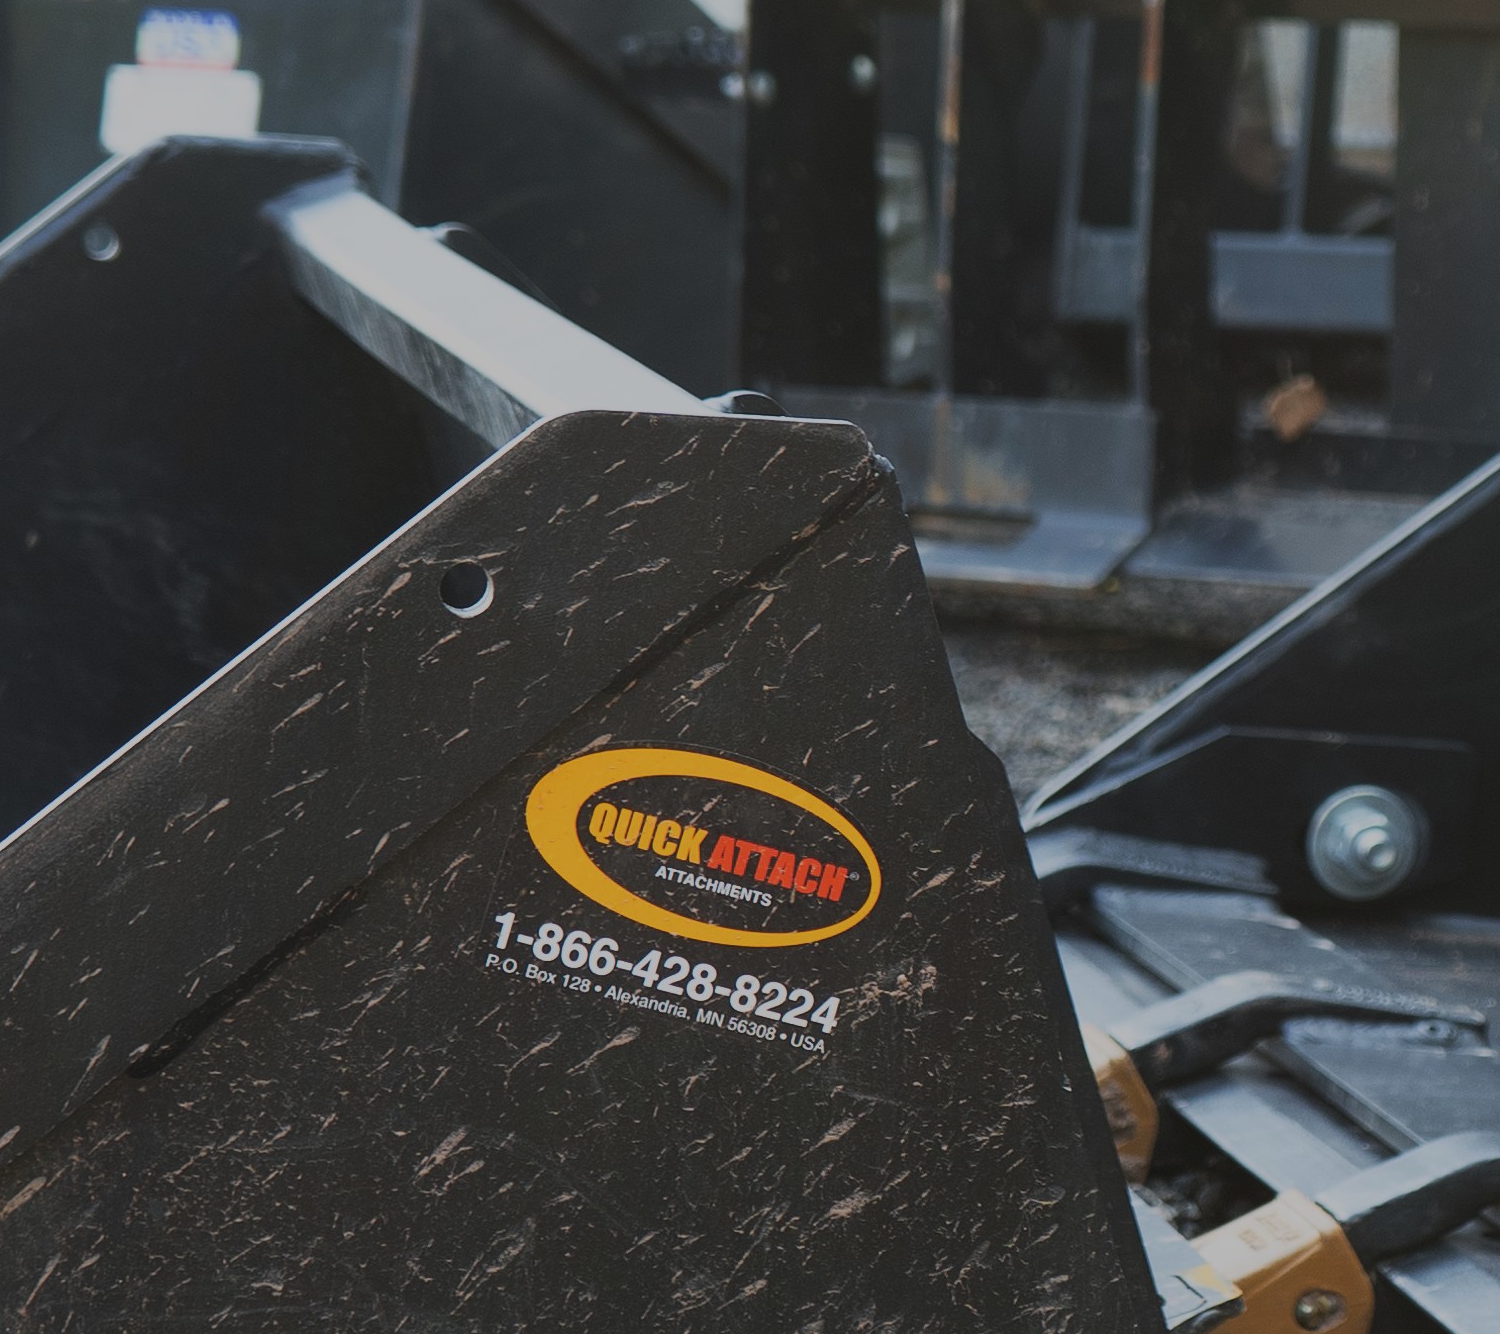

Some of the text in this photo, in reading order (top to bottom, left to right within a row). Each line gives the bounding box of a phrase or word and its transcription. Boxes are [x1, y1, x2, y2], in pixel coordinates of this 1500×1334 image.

[588, 802, 849, 902] QUICK ATTACH
[655, 866, 772, 907] ATTACHMENTS
[484, 954, 826, 1053] P.O. Box 128 Alexandria, MN 56308 USA
[494, 912, 842, 1034] 1-866-428-8224
